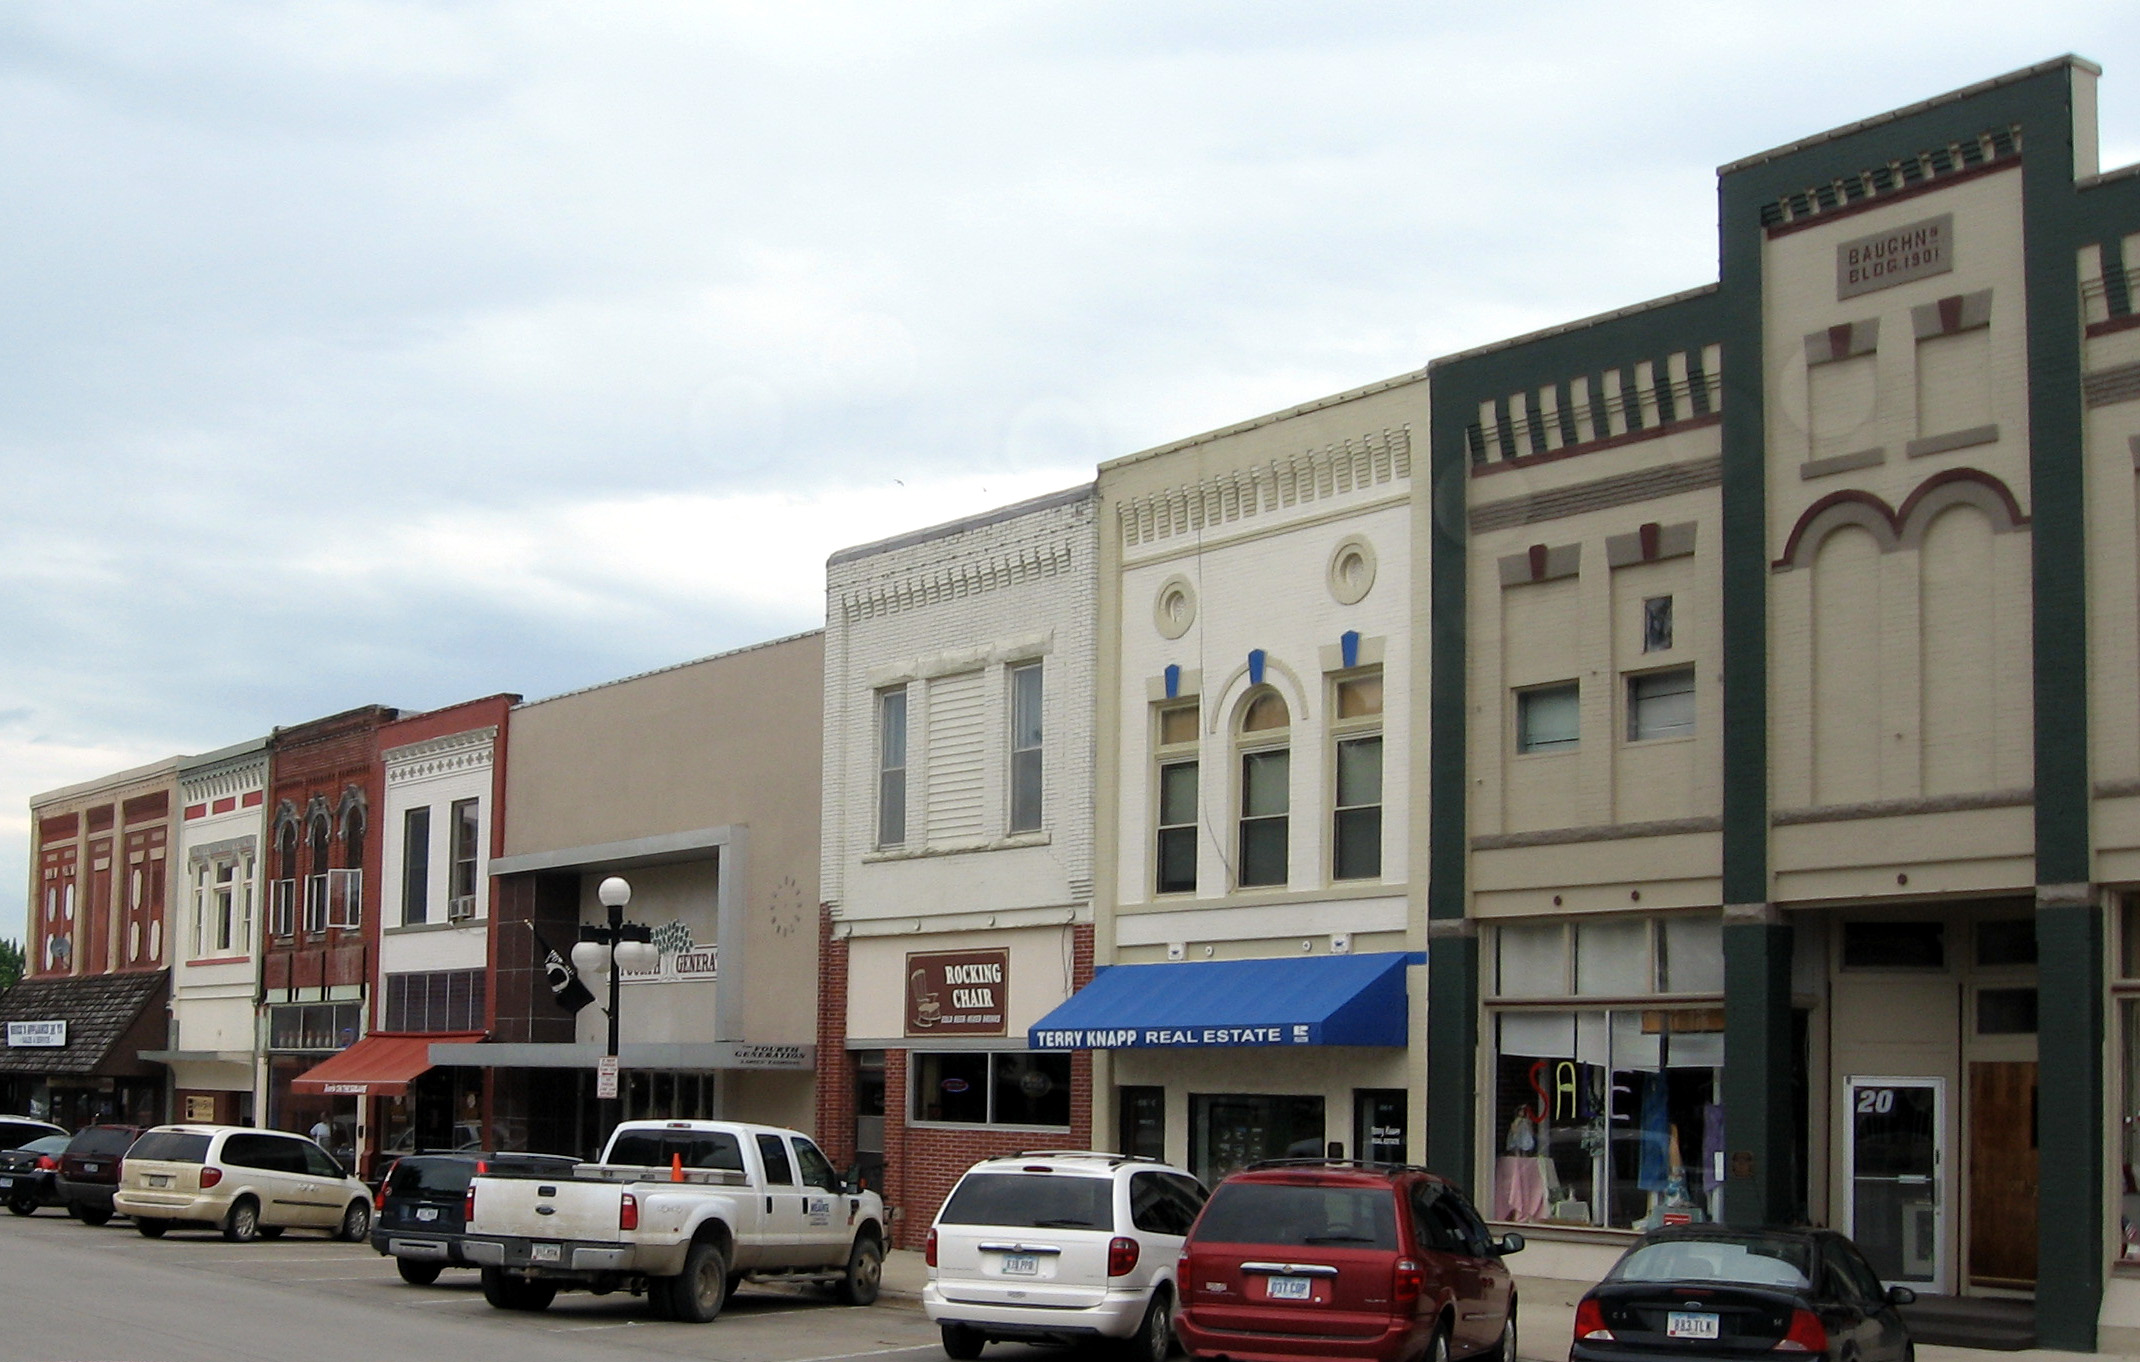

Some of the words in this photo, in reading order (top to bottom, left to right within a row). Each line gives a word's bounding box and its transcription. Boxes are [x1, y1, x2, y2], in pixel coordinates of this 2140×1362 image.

[677, 952, 717, 973] GENERA
[945, 963, 1002, 984] ROCKING
[952, 988, 994, 1008] CHAIR
[1036, 1031, 1083, 1047] TERRY
[1086, 1030, 1138, 1047] KNAPP
[1145, 1030, 1199, 1044] REAL
[1203, 1028, 1282, 1043] ESTATE
[734, 1051, 806, 1059] GENERATION
[1524, 1061, 1632, 1123] SALE
[1857, 1089, 1894, 1113] 20
